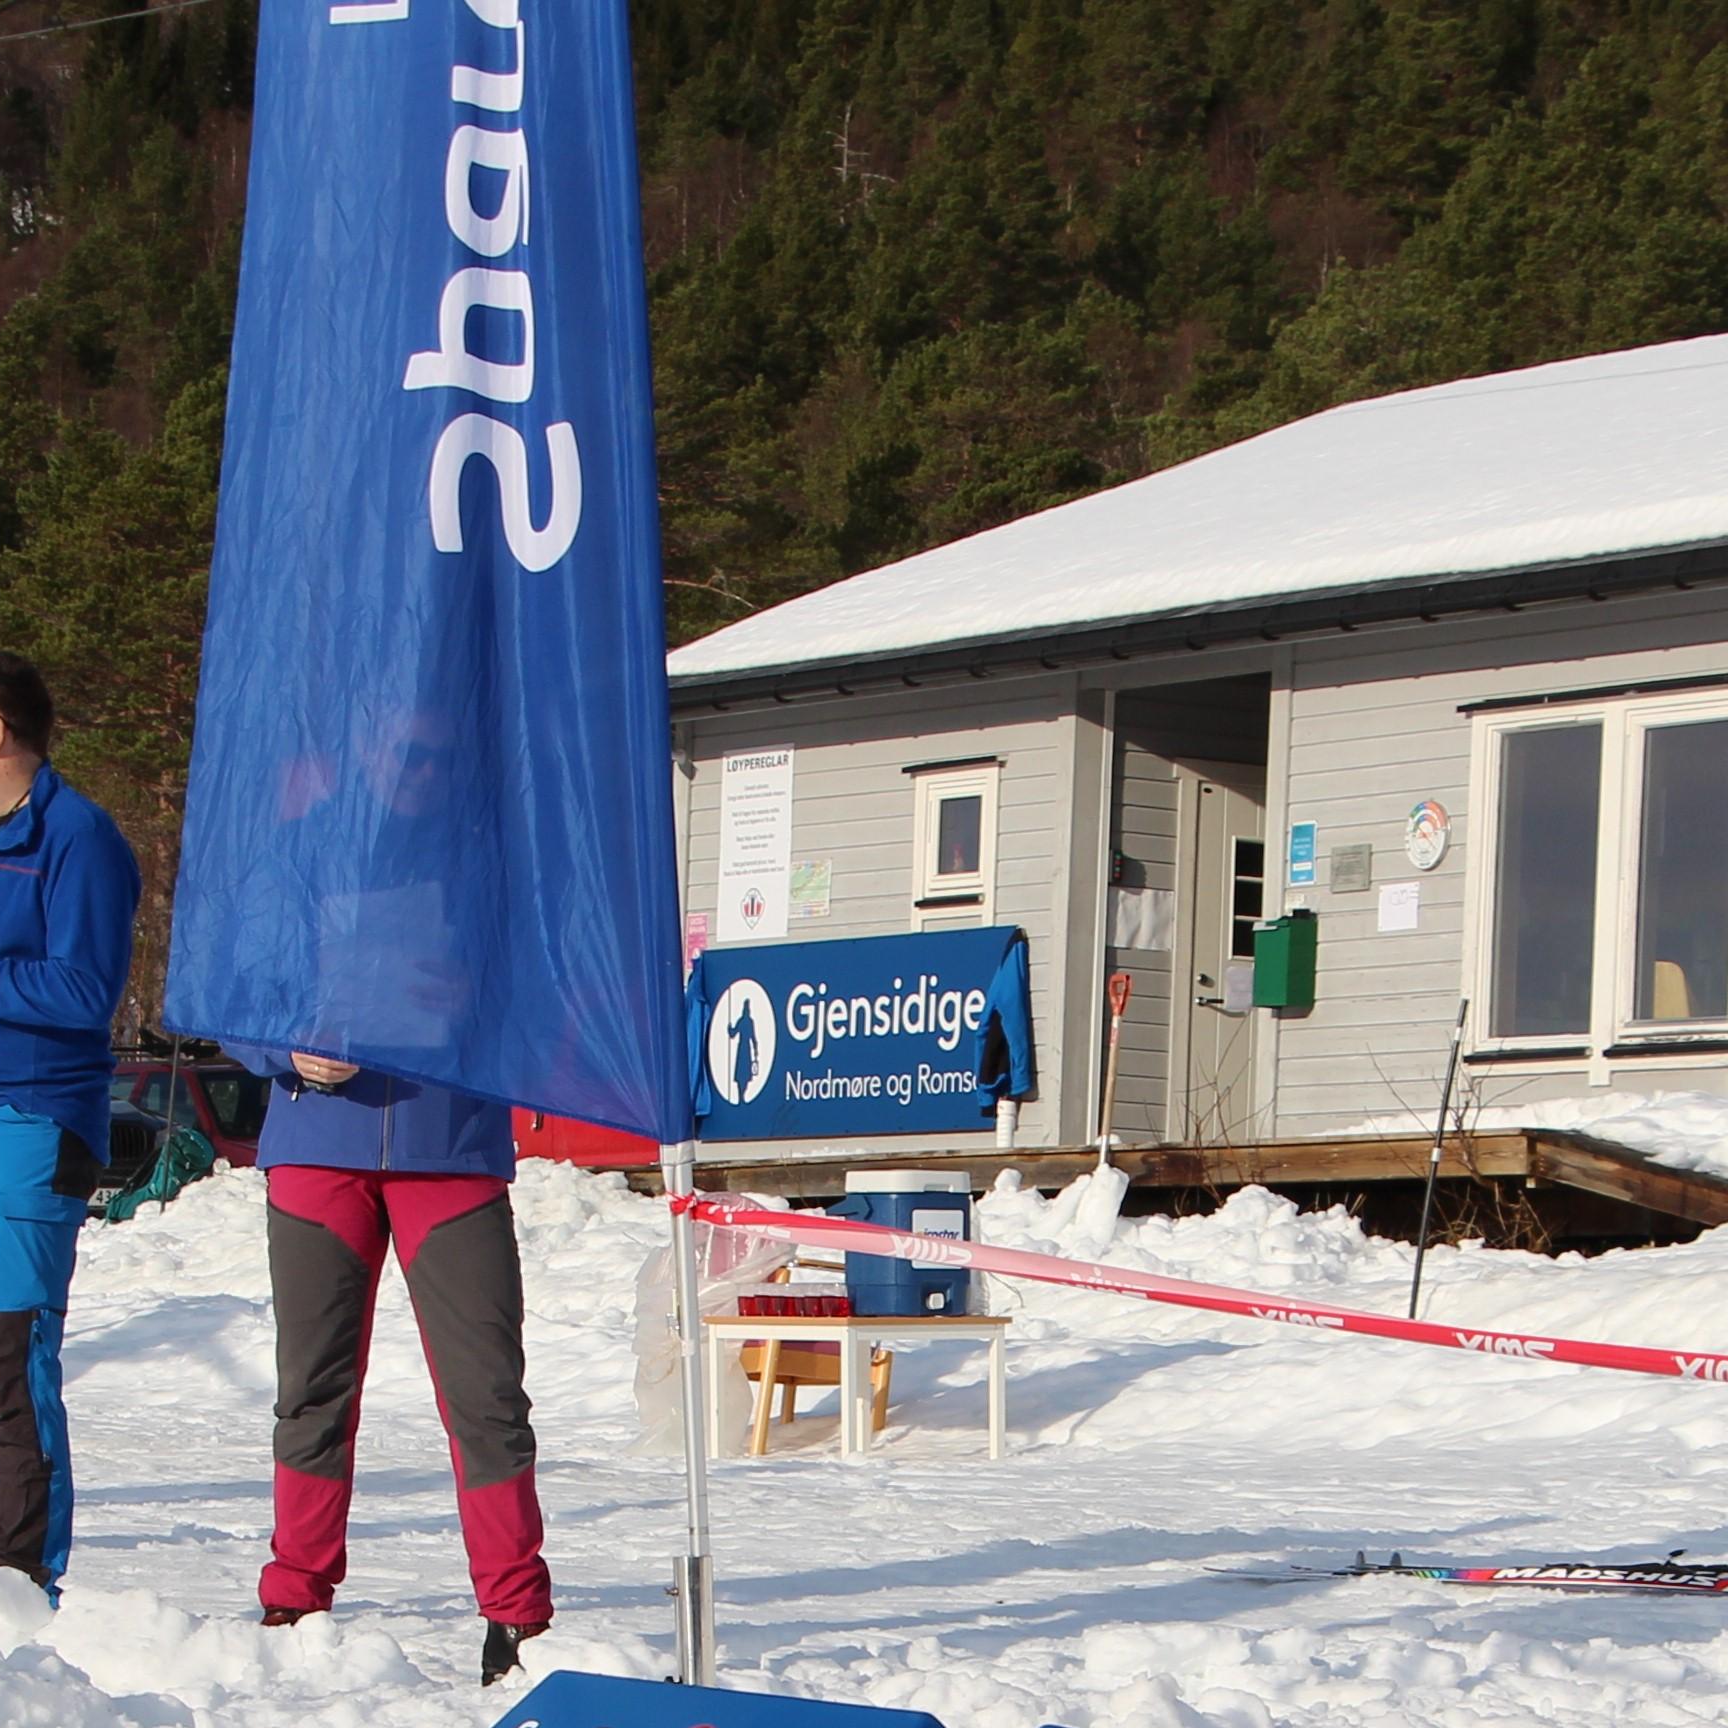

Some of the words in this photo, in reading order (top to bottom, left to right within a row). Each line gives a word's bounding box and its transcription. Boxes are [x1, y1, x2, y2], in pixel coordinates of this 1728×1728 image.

[726, 753, 789, 773] LØYPEREGLAR
[785, 974, 986, 1059] Gjensidige
[784, 1068, 882, 1101] Nordmøre
[886, 1073, 912, 1106] og
[1492, 1567, 1720, 1587] MADSHUS
